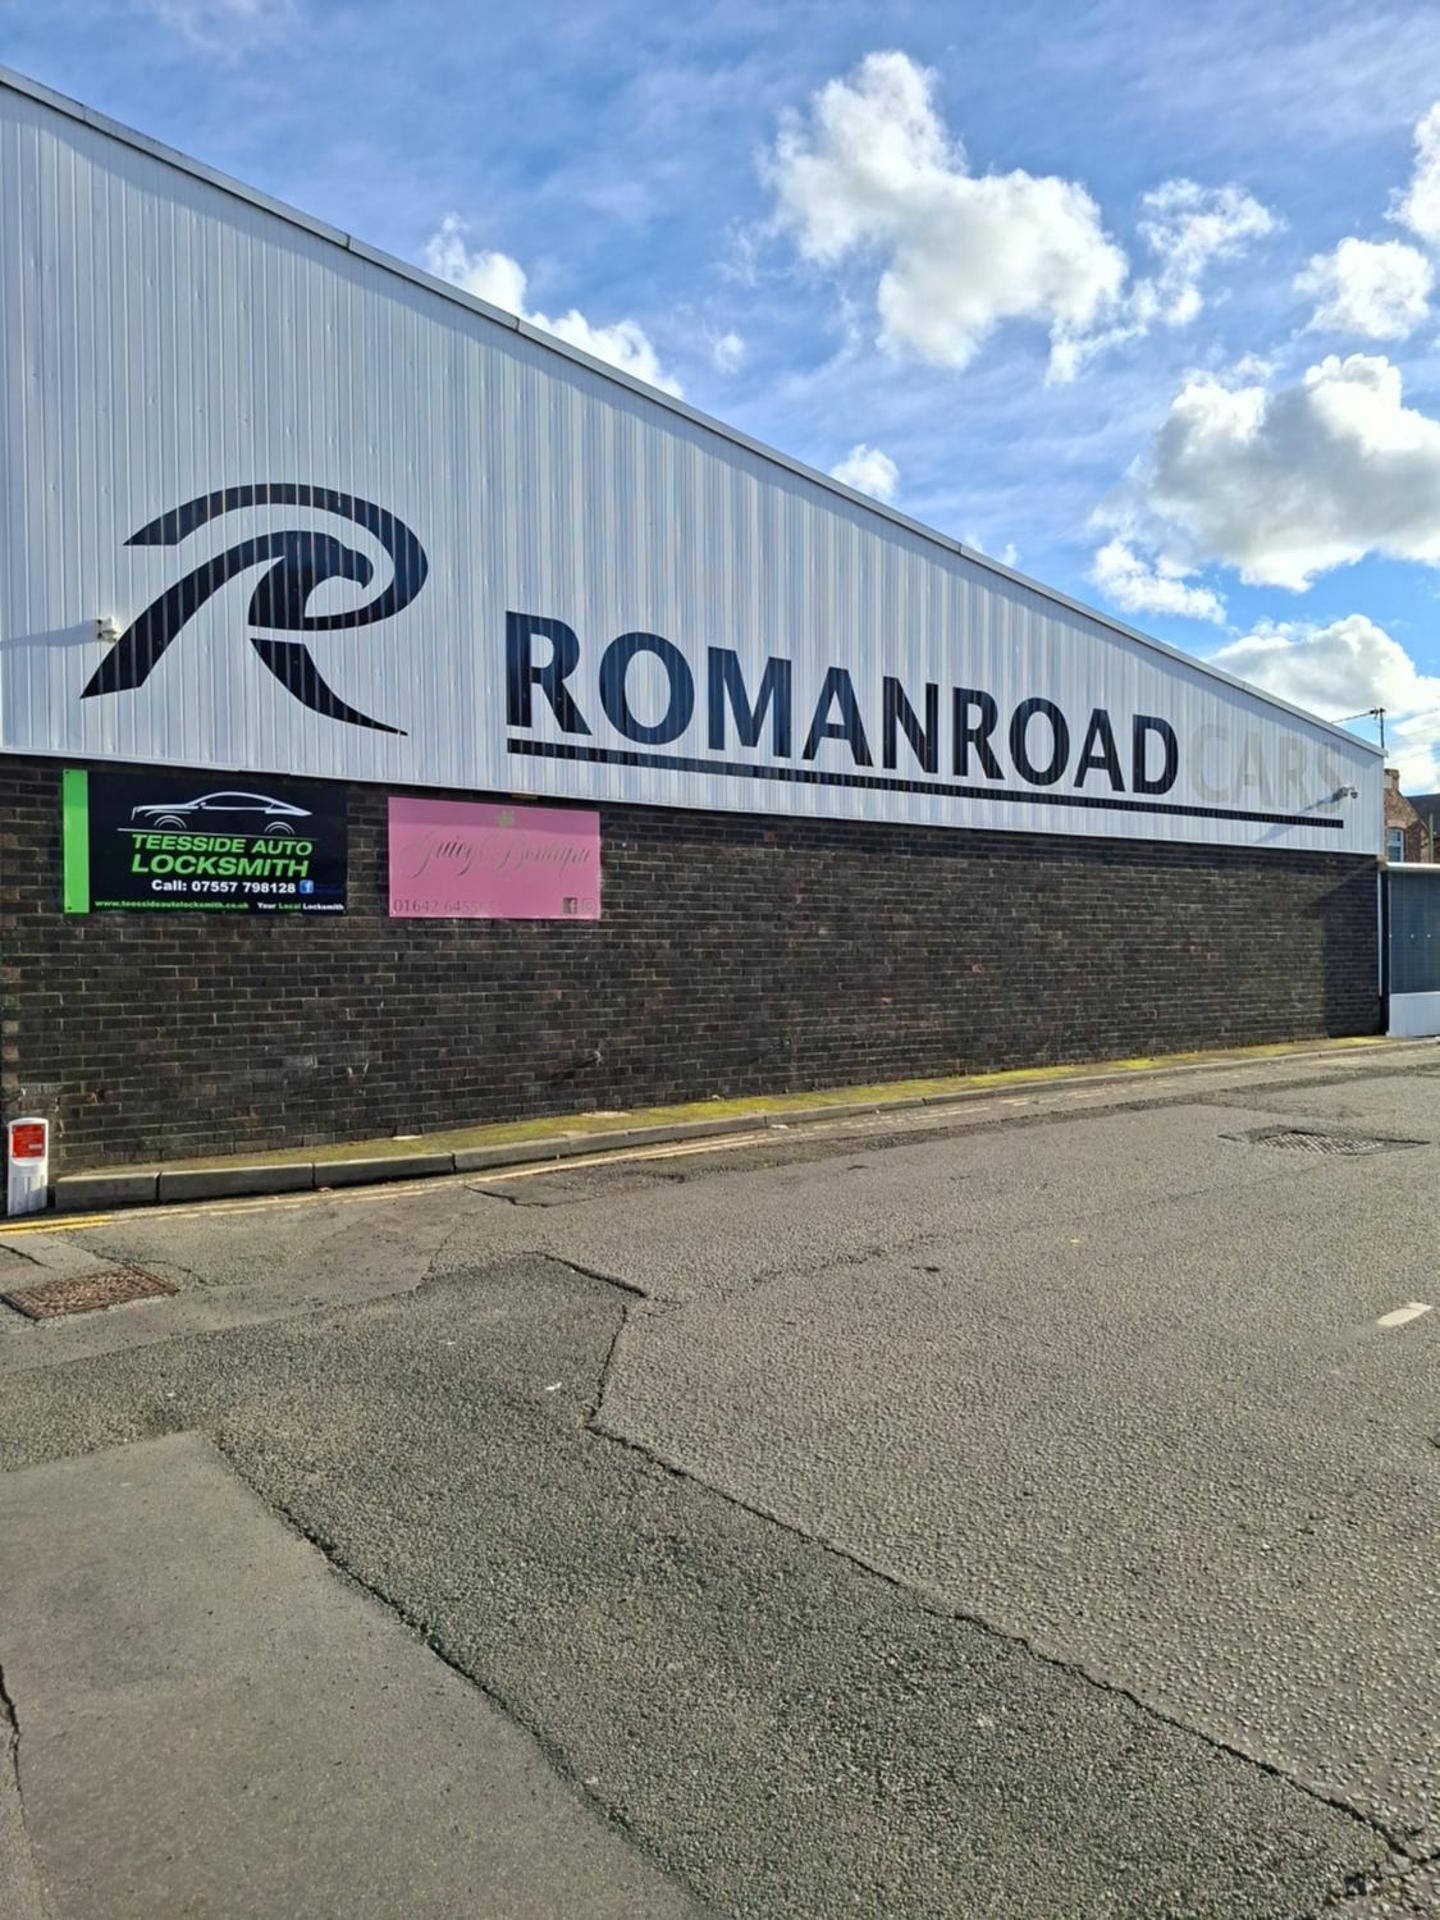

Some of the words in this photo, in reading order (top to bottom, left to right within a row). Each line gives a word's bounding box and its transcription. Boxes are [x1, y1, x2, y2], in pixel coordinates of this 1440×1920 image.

[132, 833, 246, 853] TEESSIDE
[252, 839, 313, 856] AUTO
[131, 853, 309, 878] LOCKSMITH
[151, 878, 188, 892] Call:
[191, 880, 238, 893] 07557
[243, 881, 297, 894] 798128
[257, 901, 277, 910] Your
[278, 902, 301, 911] Local
[302, 902, 345, 911] Locksmith
[393, 898, 439, 913] 01642
